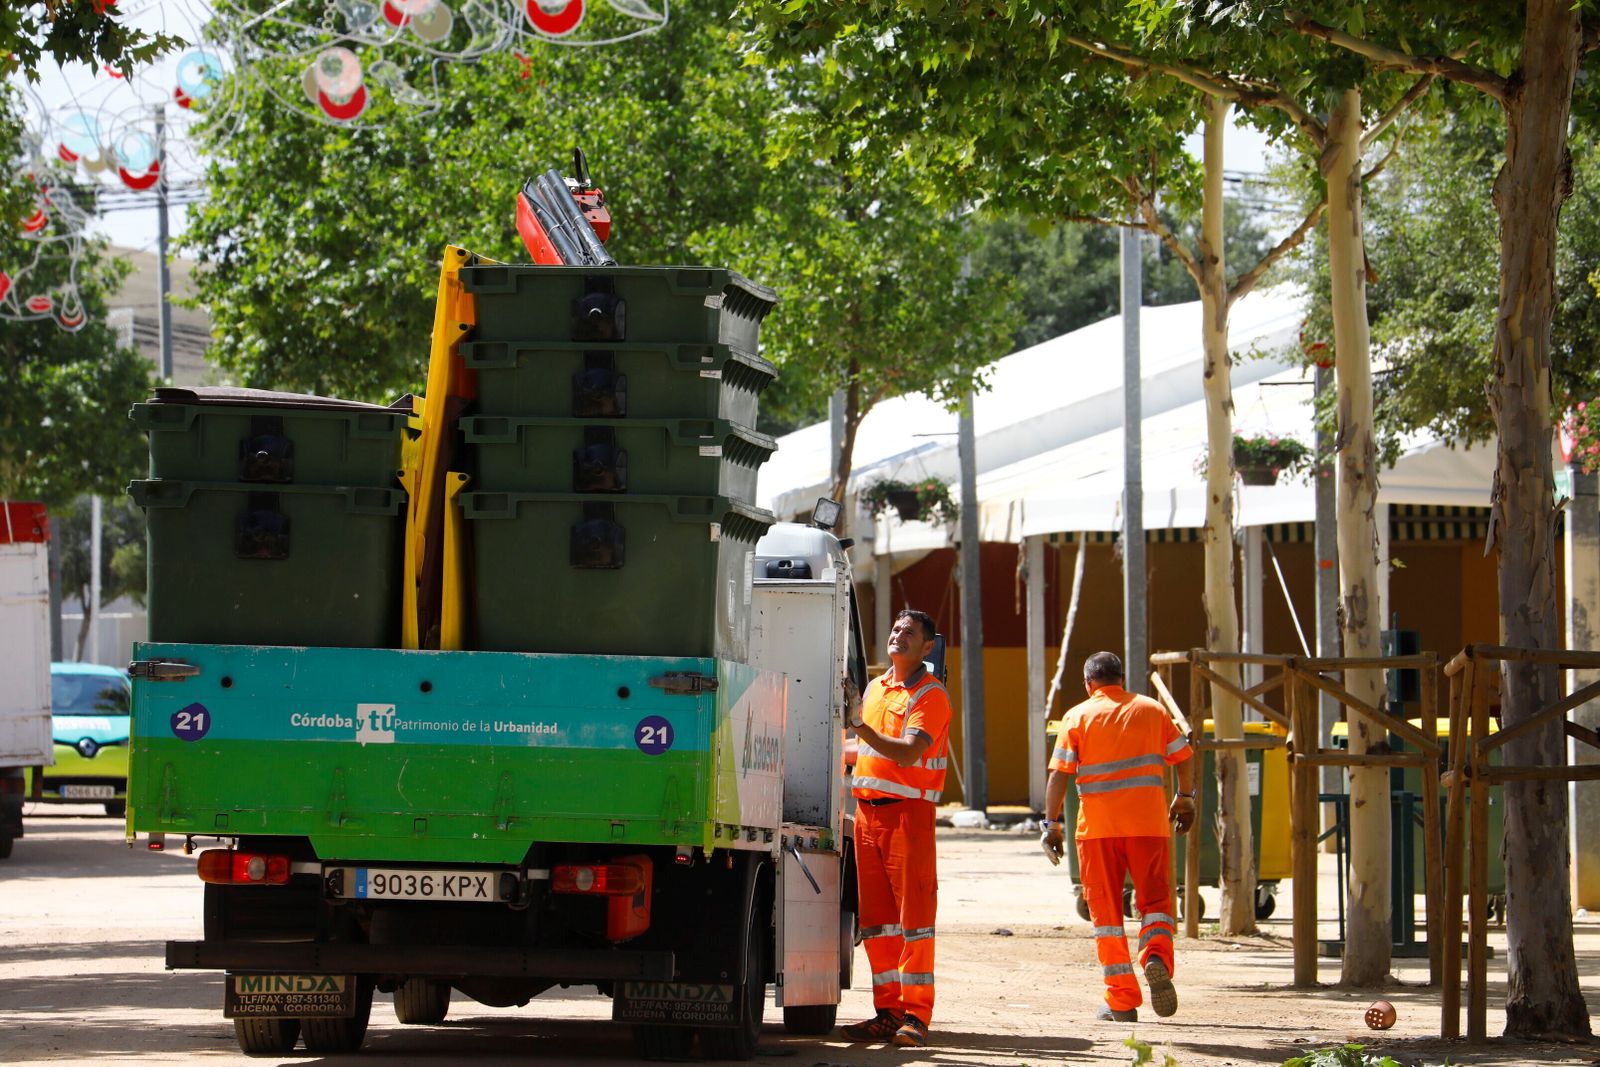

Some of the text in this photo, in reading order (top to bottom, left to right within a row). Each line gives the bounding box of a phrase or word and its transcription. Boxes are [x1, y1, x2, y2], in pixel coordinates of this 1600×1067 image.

[176, 712, 205, 731] 21
[290, 707, 558, 735] Córdoba y tú Patrimonio de la Urbanidad
[640, 725, 668, 745] 21
[373, 874, 487, 898] 9036 KPX
[240, 975, 340, 993] MINDA
[630, 981, 727, 1001] MINDA
[233, 1004, 277, 1013] LUCENA
[239, 995, 340, 1004] TLF/FAX: 957-511340
